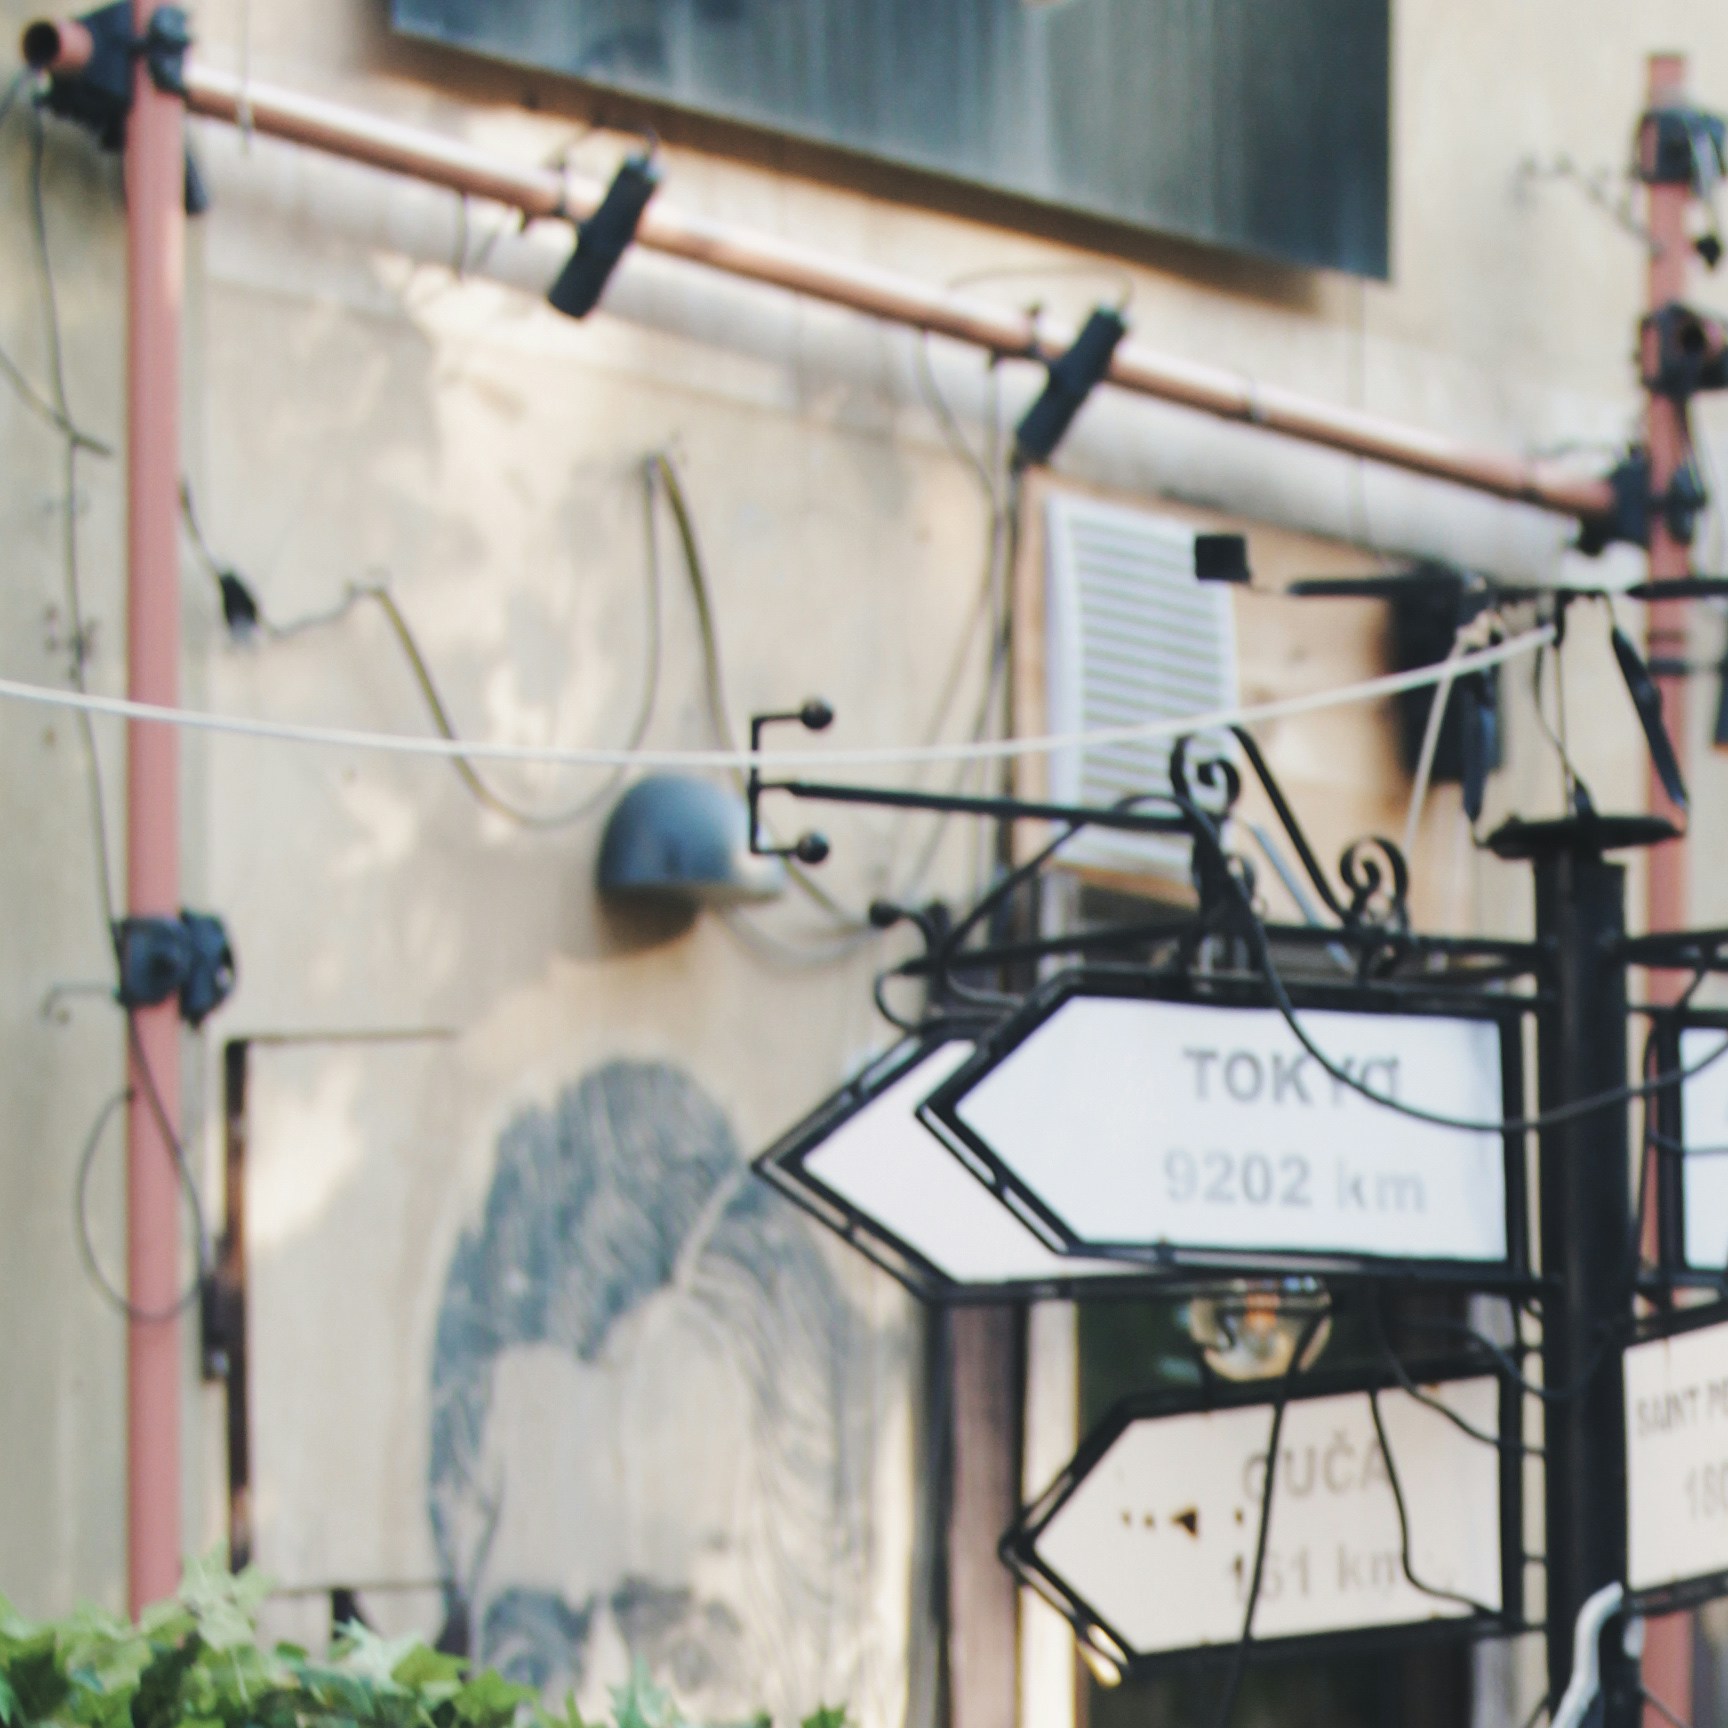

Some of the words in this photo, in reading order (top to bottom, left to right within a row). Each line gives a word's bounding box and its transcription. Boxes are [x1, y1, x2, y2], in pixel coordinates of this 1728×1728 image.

[1182, 1046, 1400, 1111] TOKYO
[1163, 1147, 1312, 1209] 9202
[1336, 1155, 1428, 1214] km
